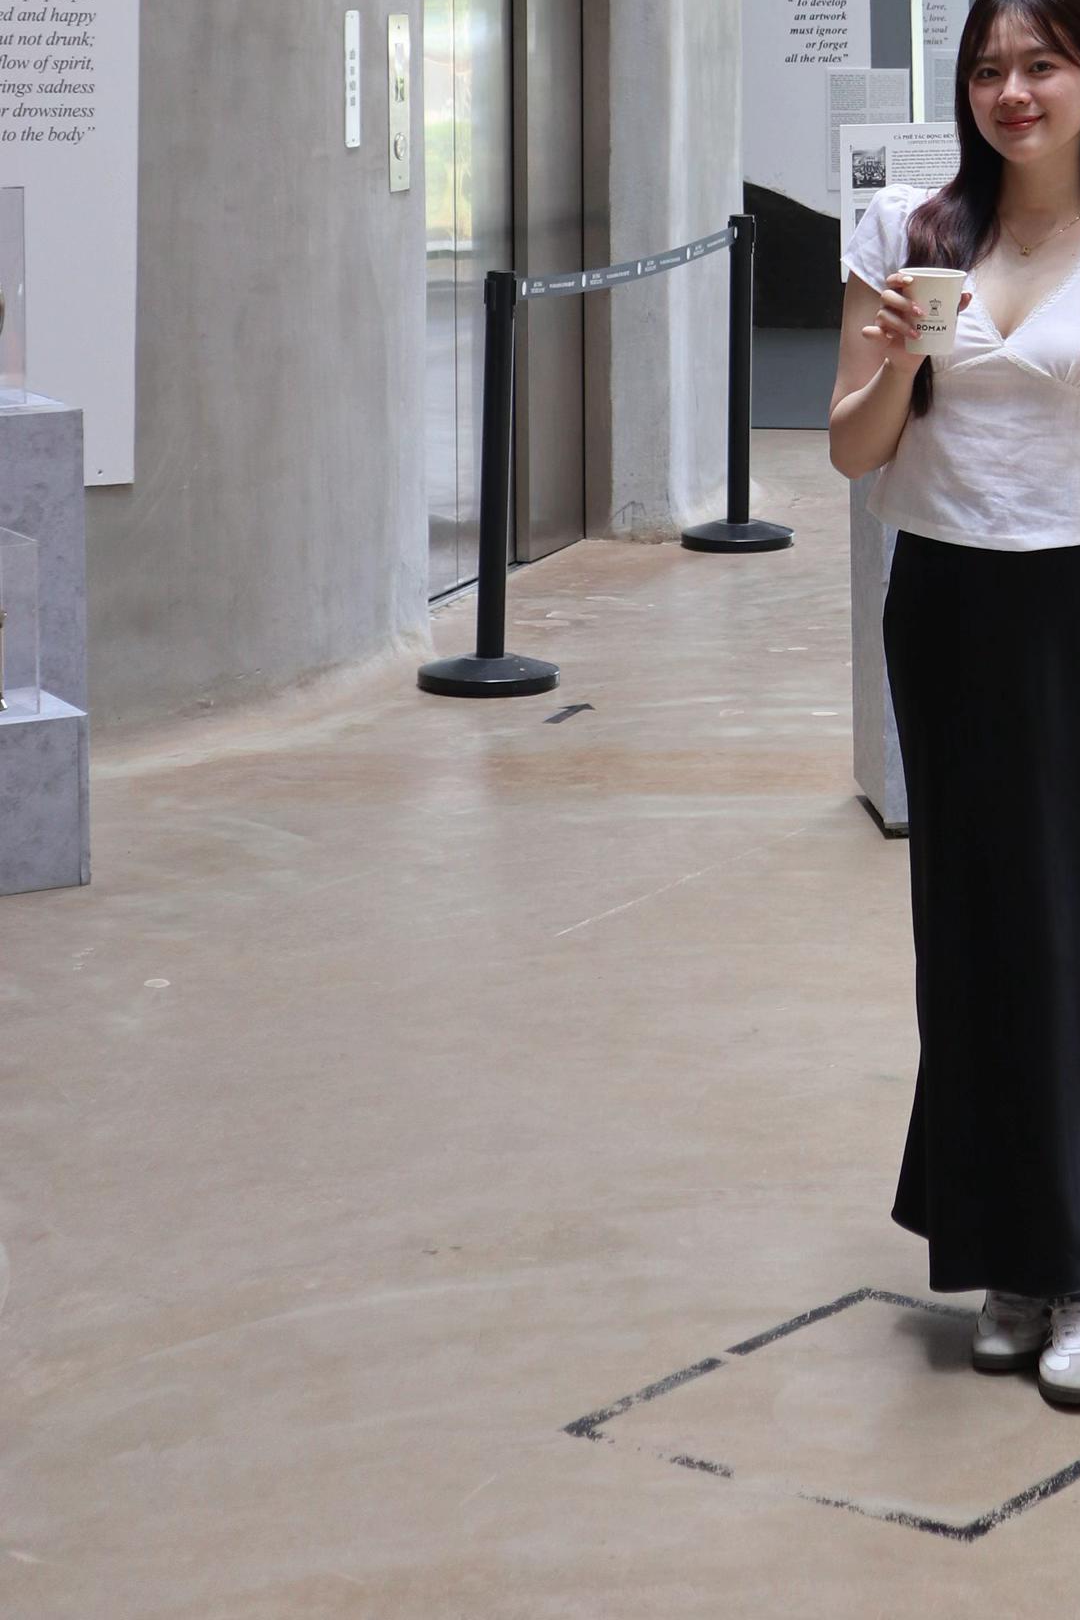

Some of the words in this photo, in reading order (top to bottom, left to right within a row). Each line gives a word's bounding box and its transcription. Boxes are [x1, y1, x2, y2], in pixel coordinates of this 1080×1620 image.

[17, 7, 47, 22] and
[50, 7, 97, 26] happy
[809, 11, 846, 21] artwork
[790, 27, 814, 35] must
[816, 25, 848, 37] ignore
[17, 33, 42, 46] not
[45, 31, 96, 47] drunk;
[817, 39, 848, 51] forget
[33, 54, 53, 74] of
[785, 54, 798, 63] all
[800, 54, 815, 63] the
[37, 79, 95, 94] sadness
[12, 103, 95, 118] drowsiness
[1, 128, 17, 142] to
[21, 126, 44, 142] the
[916, 324, 947, 332] ROMAN
